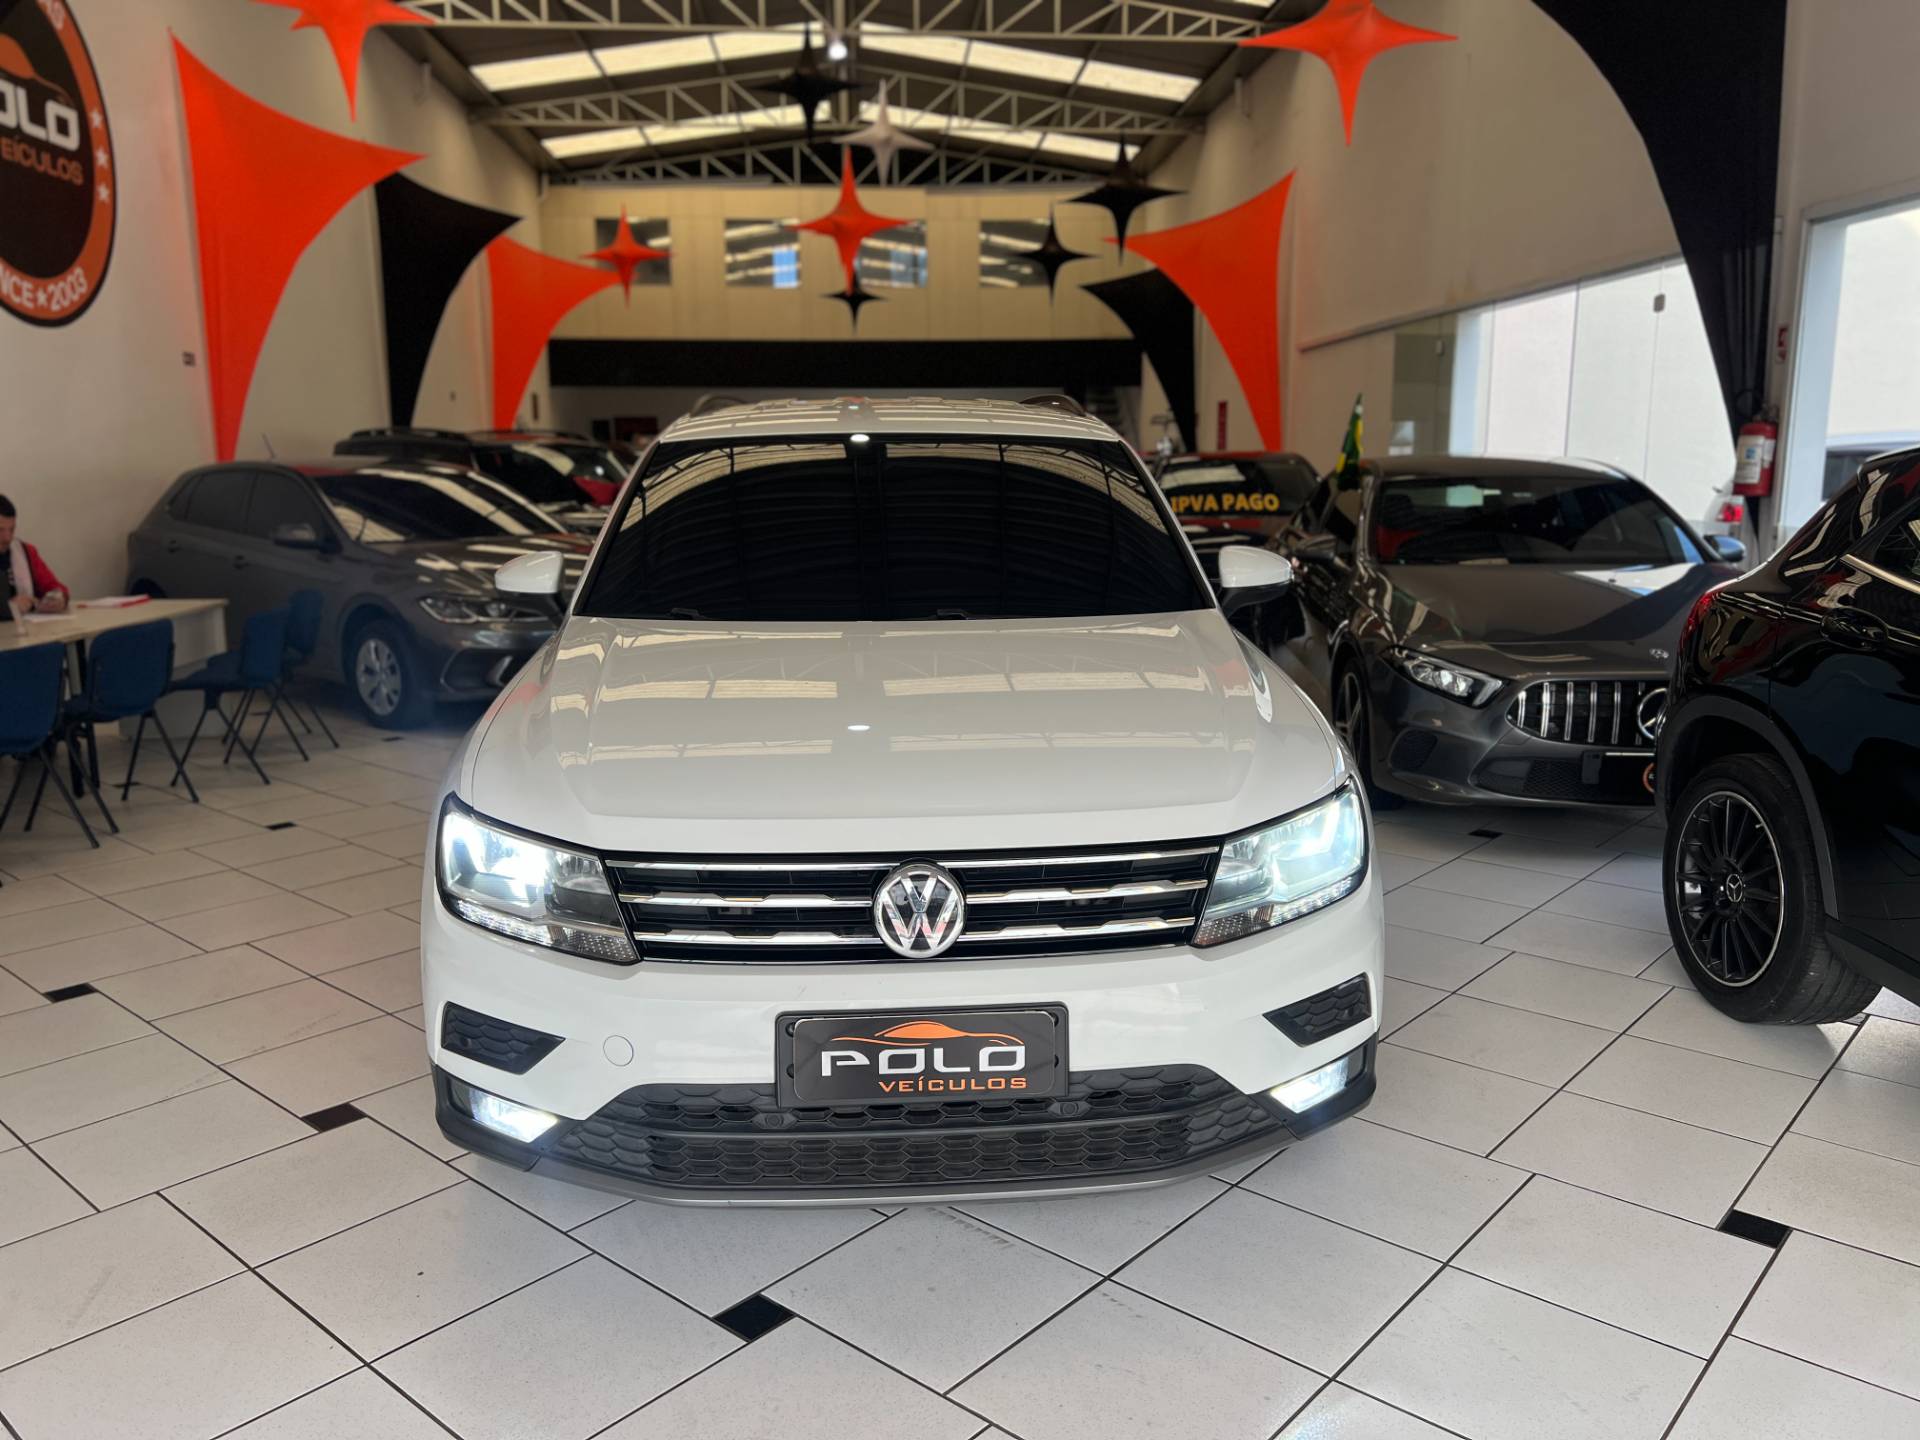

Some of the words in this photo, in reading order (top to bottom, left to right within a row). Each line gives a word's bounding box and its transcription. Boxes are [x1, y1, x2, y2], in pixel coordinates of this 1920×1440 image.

[48, 267, 88, 312] 2003
[1170, 494, 1218, 513] IPVA
[1222, 492, 1280, 512] PAGO
[877, 867, 961, 955] VW
[821, 1045, 1026, 1077] POLO
[878, 1075, 1027, 1093] VEÍCULOS
